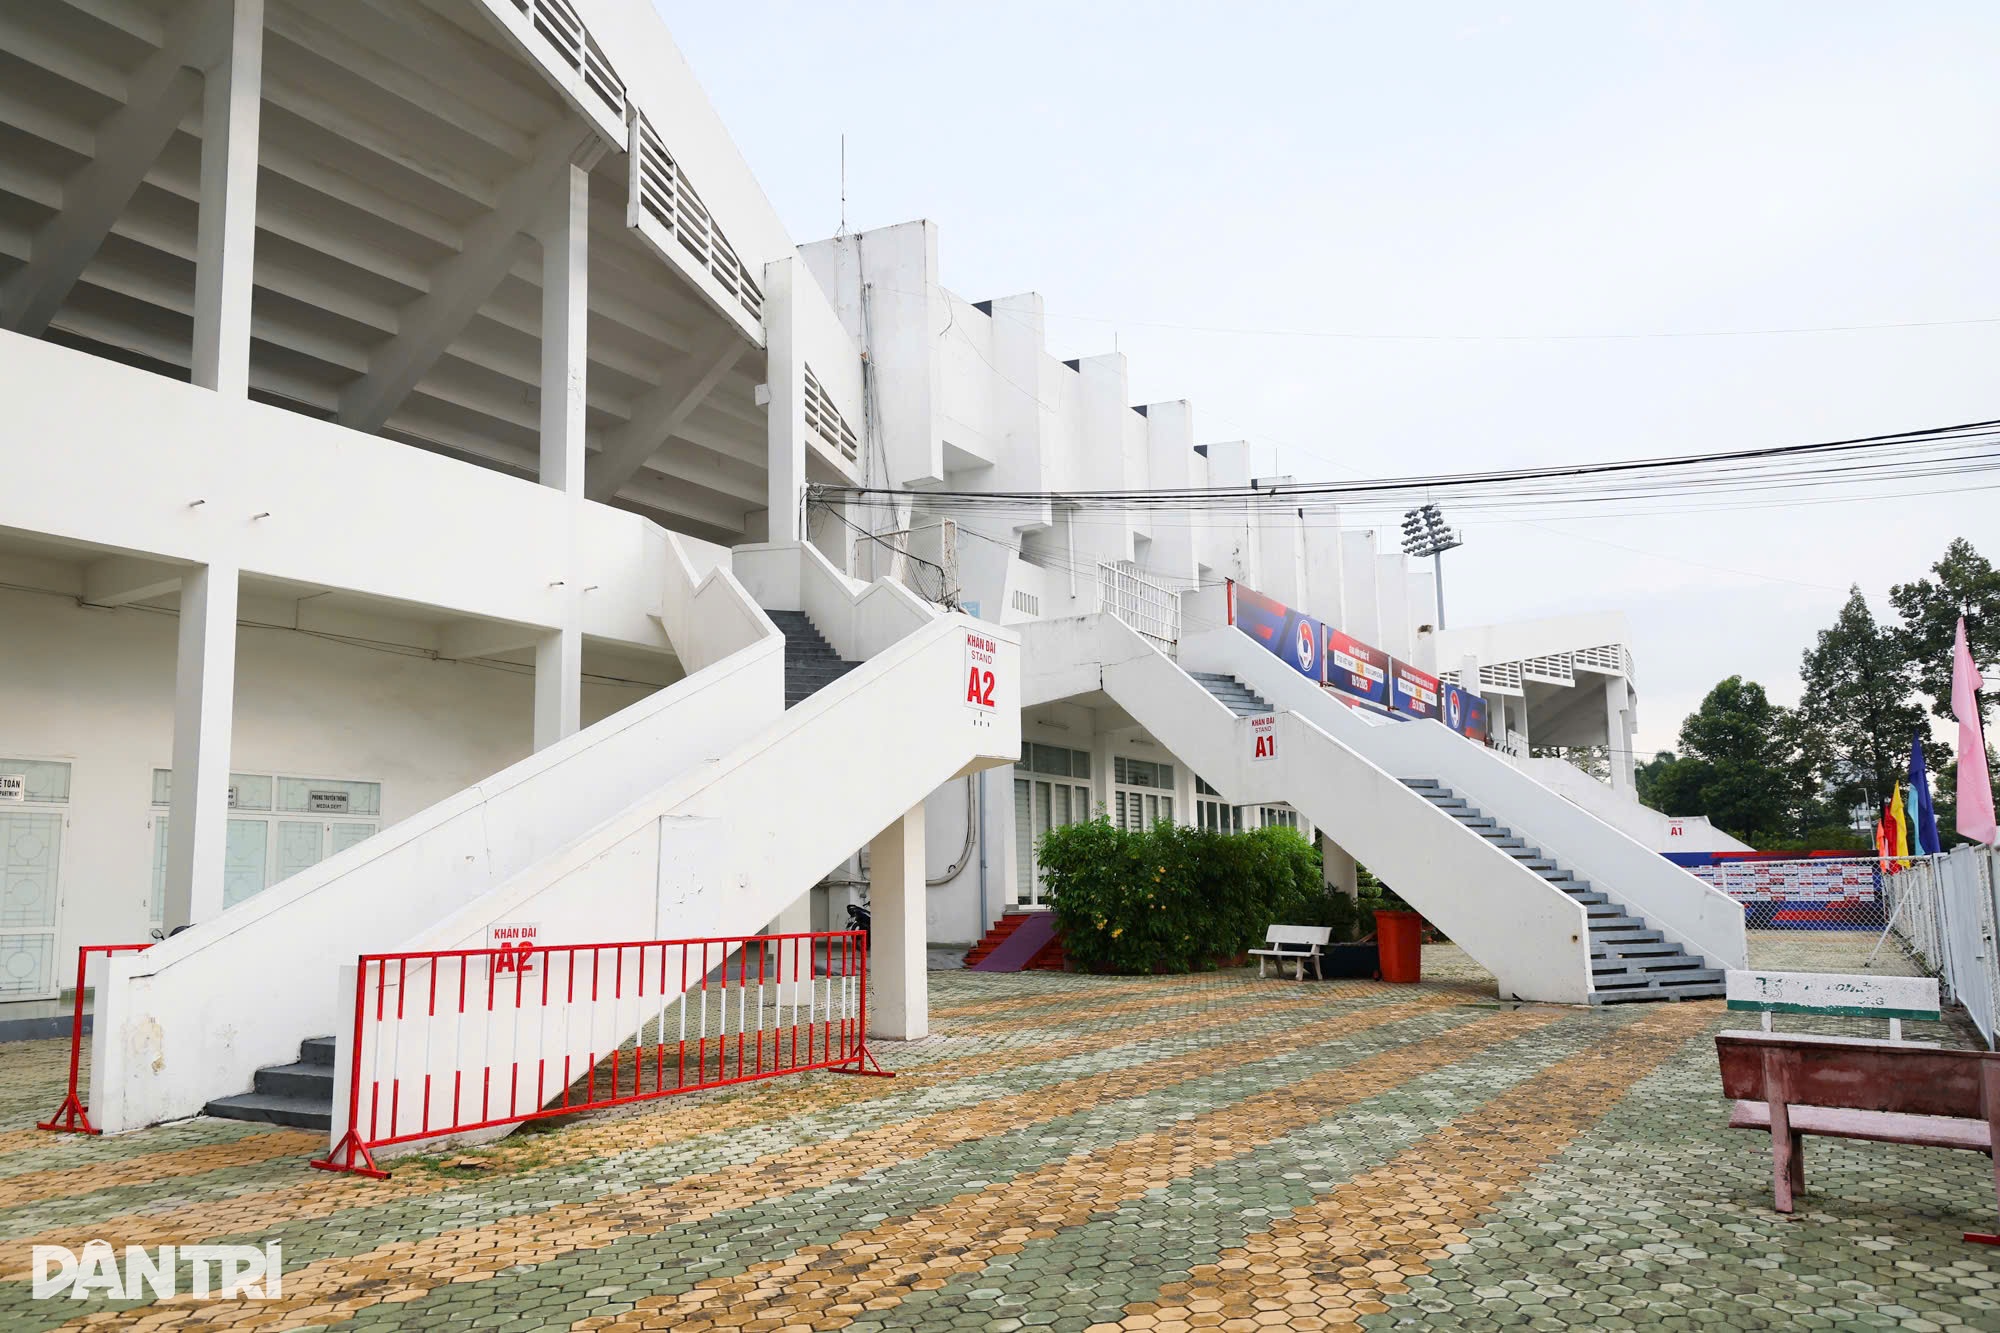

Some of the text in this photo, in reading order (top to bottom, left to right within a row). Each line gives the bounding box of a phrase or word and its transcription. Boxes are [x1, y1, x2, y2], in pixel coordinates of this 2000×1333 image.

[971, 650, 992, 664] STAND
[967, 666, 995, 707] A2
[1255, 735, 1274, 758] A1
[1671, 827, 1682, 836] A1
[496, 941, 533, 973] A2
